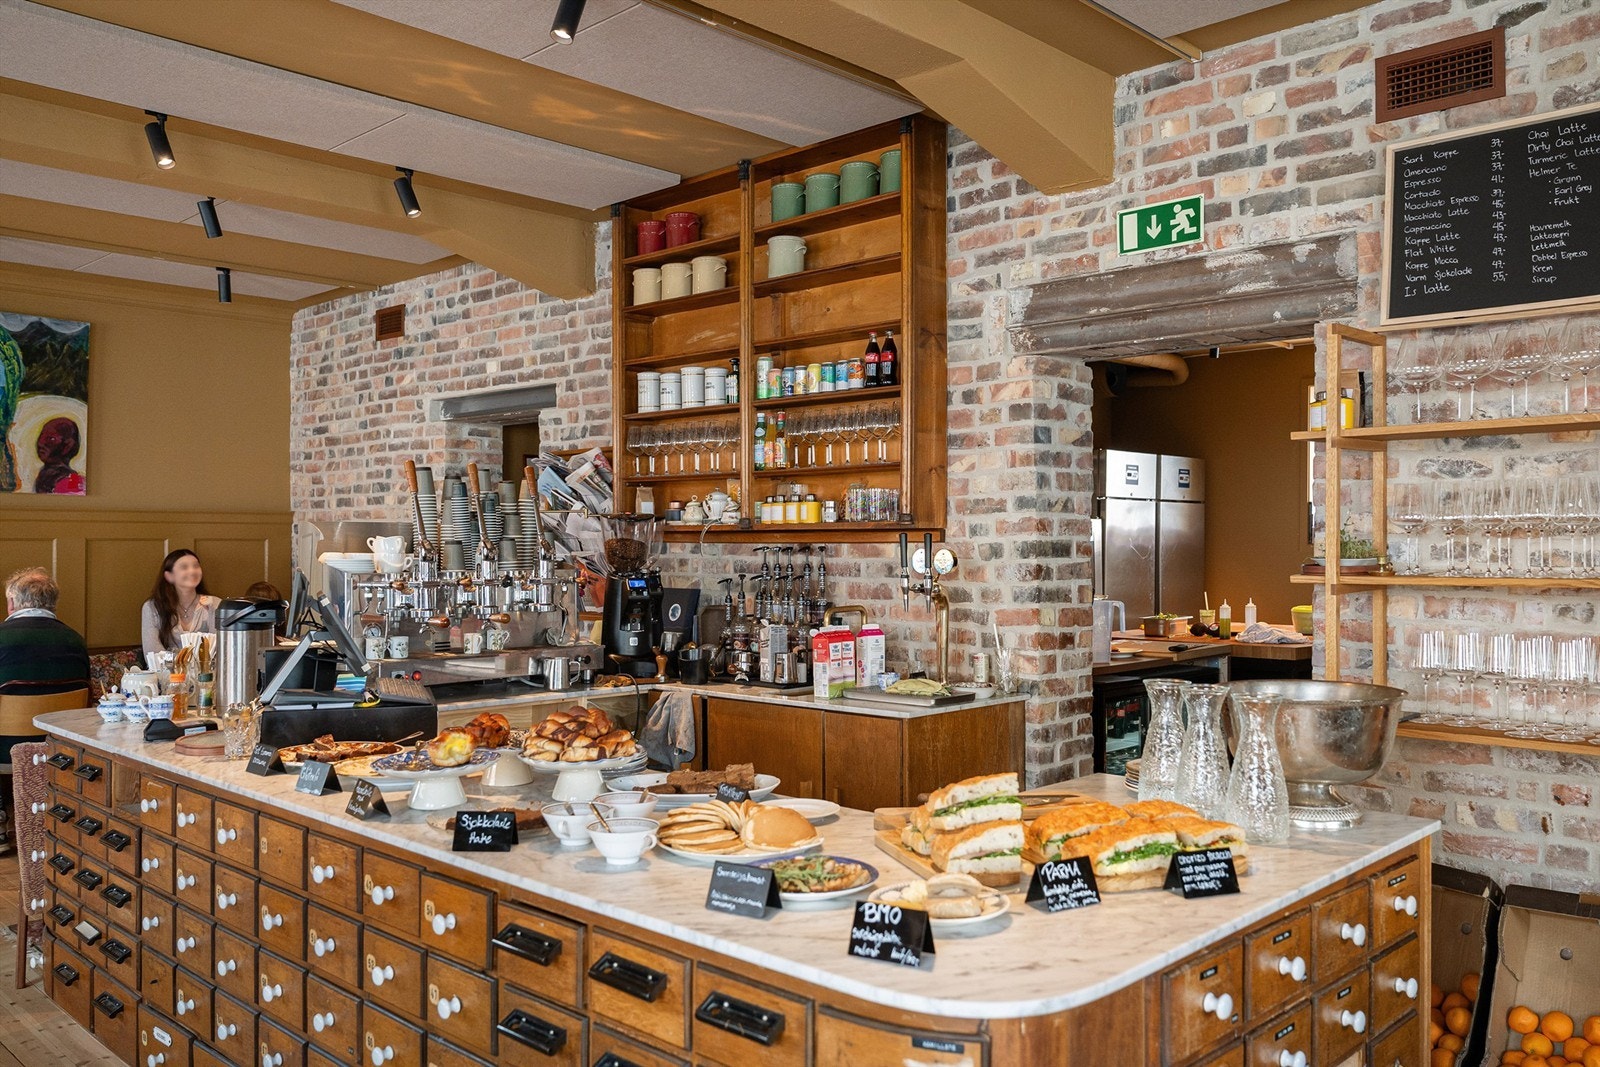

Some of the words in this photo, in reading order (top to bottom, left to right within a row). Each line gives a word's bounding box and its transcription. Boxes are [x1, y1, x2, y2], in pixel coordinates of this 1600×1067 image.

[1528, 128, 1549, 139] Chai
[1558, 122, 1587, 135] Latte
[1527, 141, 1551, 153] Dirty
[1555, 138, 1574, 147] Chai
[1527, 152, 1568, 165] Turmeric
[1403, 177, 1442, 189] Espresso
[1403, 189, 1441, 200] Cortado
[1554, 186, 1573, 196] Earl
[1553, 195, 1580, 206] Frukt
[1447, 207, 1471, 217] Latte
[1403, 222, 1452, 235] Cappuccino
[1529, 220, 1572, 232] Havremelk
[1435, 232, 1461, 242] Latte
[1404, 248, 1425, 257] Flat
[1429, 244, 1456, 254] White
[1531, 240, 1566, 252] Lettmelk
[1434, 256, 1459, 265] Mocca
[1531, 252, 1557, 263] Dobbel
[1532, 265, 1553, 273] Krem
[1405, 274, 1427, 282] Varm
[1532, 275, 1557, 284] Sirup
[1404, 286, 1417, 297] Is
[1423, 282, 1451, 294] Latte
[859, 902, 902, 925] BMO
